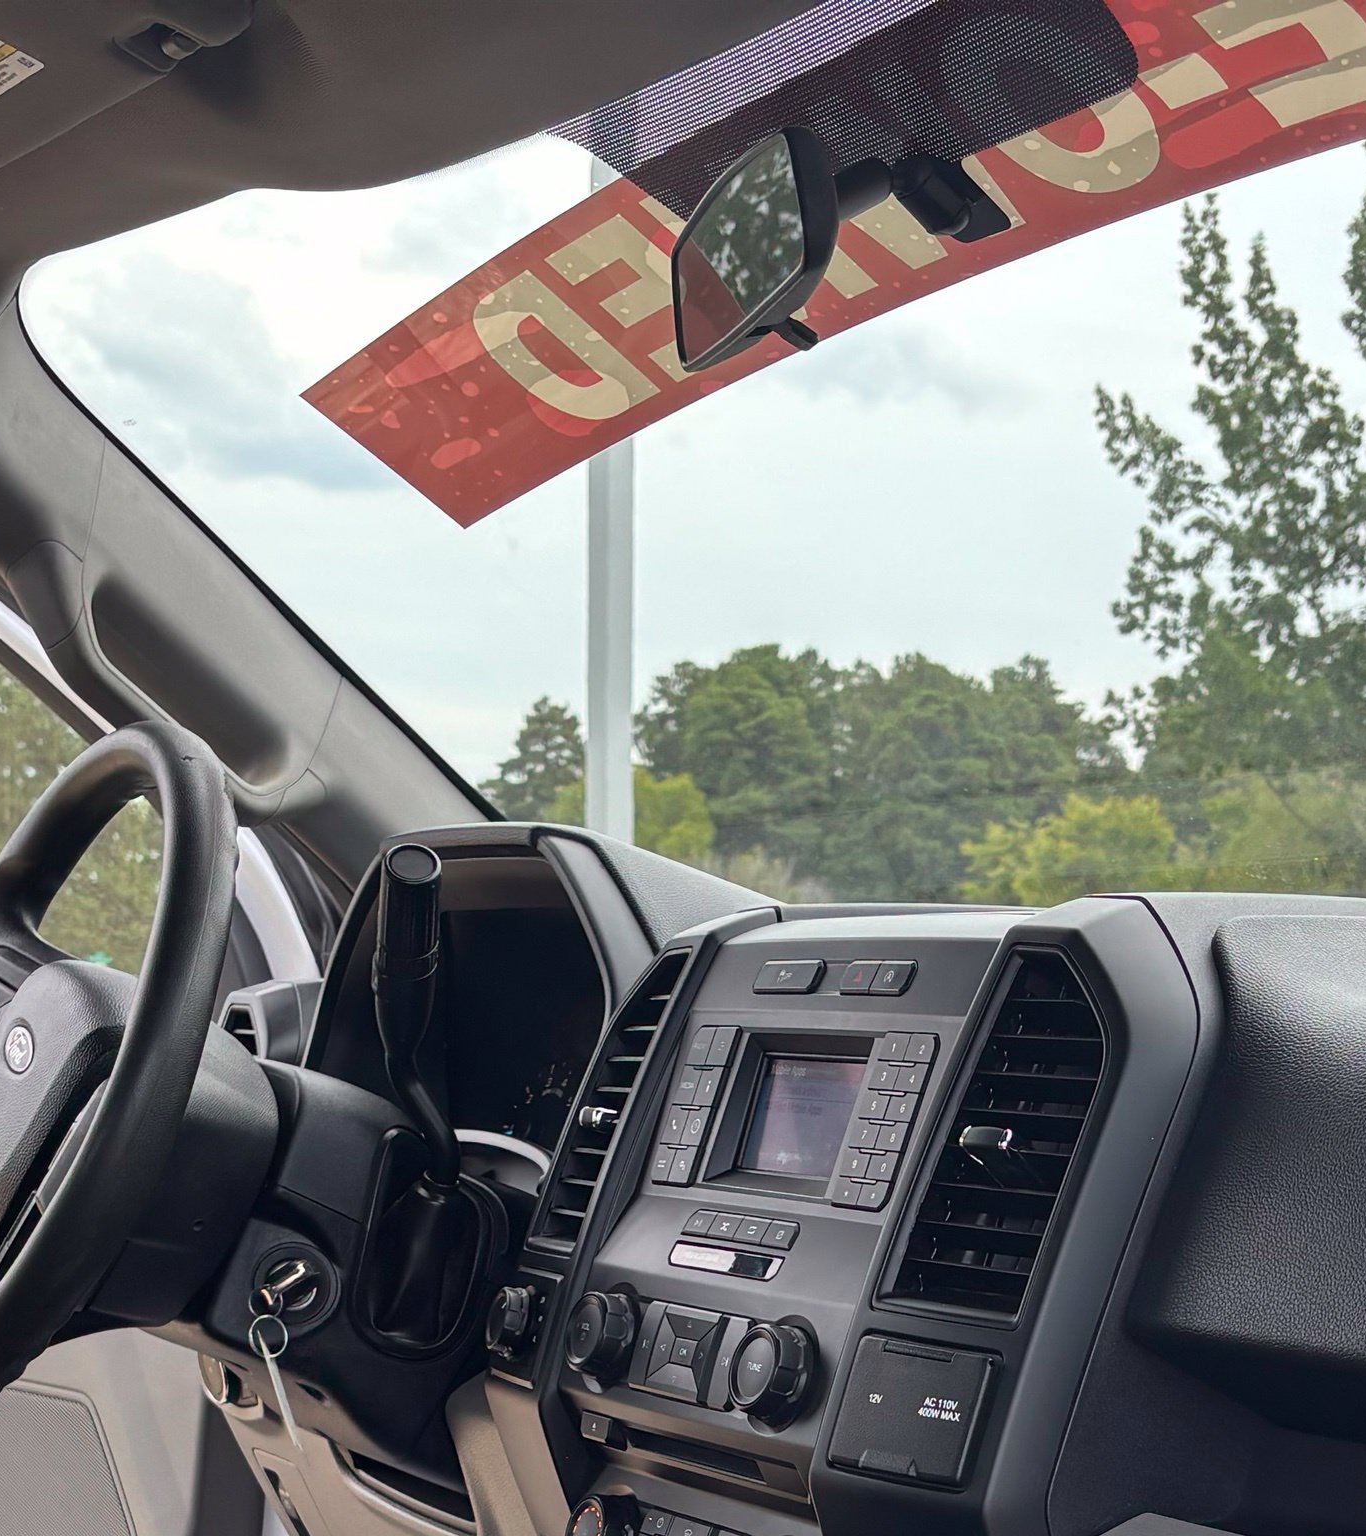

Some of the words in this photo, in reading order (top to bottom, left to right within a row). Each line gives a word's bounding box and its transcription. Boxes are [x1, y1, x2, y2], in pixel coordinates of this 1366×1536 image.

[6, 1027, 30, 1068] Ford
[890, 1042, 897, 1053] 1
[918, 1044, 926, 1056] 2
[880, 1070, 887, 1083] 3
[908, 1073, 916, 1085] 4
[870, 1100, 878, 1112] 5
[898, 1102, 907, 1114] 6
[860, 1129, 868, 1141] 7
[888, 1131, 897, 1144] 8
[851, 1158, 858, 1170] 9
[747, 1362, 762, 1373] TUNE
[869, 1394, 883, 1404] 12V
[923, 1397, 936, 1407] AC
[938, 1399, 958, 1410] 110V
[918, 1407, 939, 1418] 400W
[940, 1411, 961, 1422] MAX
